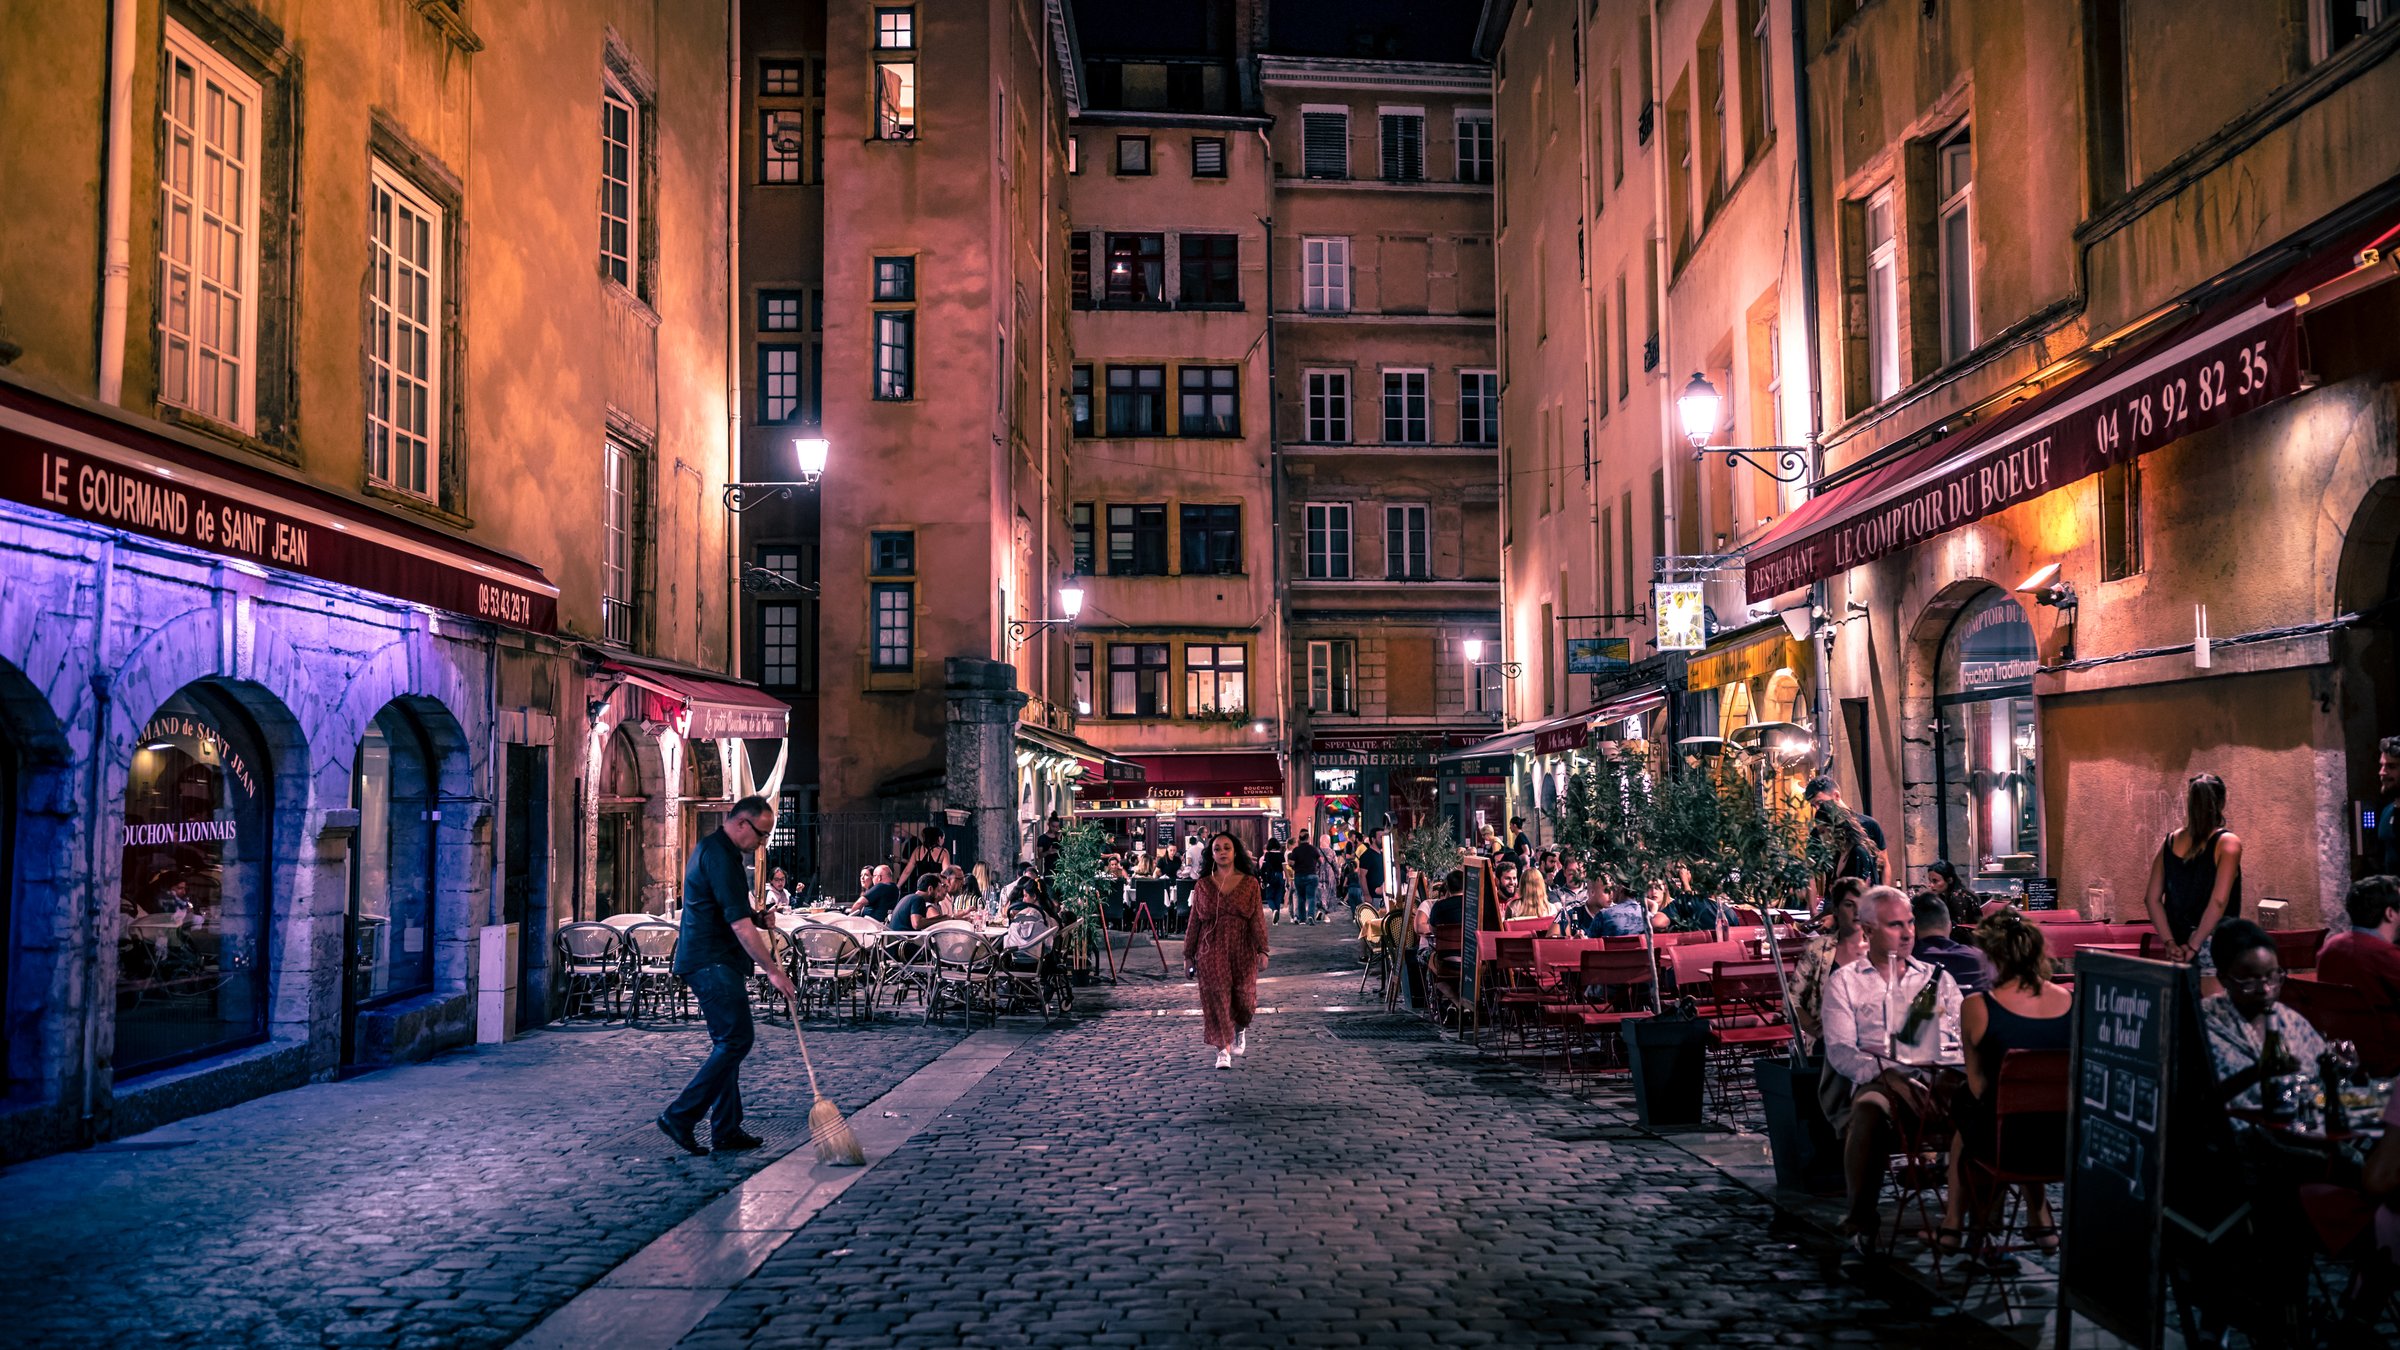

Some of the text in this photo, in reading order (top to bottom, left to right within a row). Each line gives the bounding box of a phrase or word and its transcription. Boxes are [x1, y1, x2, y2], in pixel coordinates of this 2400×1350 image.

[2097, 340, 2268, 453] 04 78 92 82 35
[42, 452, 308, 567] LE GOURMAND de SAINT JEAN
[1752, 436, 2051, 594] RESTAURANT LE COMPTOIR DU BOEUF
[479, 583, 530, 625] 09 53 43 29 74
[2007, 604, 2018, 622] DU
[2320, 692, 2330, 713] 2
[182, 718, 194, 736] de
[197, 722, 231, 759] SAINT
[231, 753, 256, 799] JEAN
[1325, 741, 1377, 750] SPECIALITE
[1147, 786, 1184, 799] fiston
[179, 820, 236, 842] LYONNAIS
[2095, 984, 2151, 1026] Le Comptoir
[2098, 1016, 2143, 1049] du Boeuf
